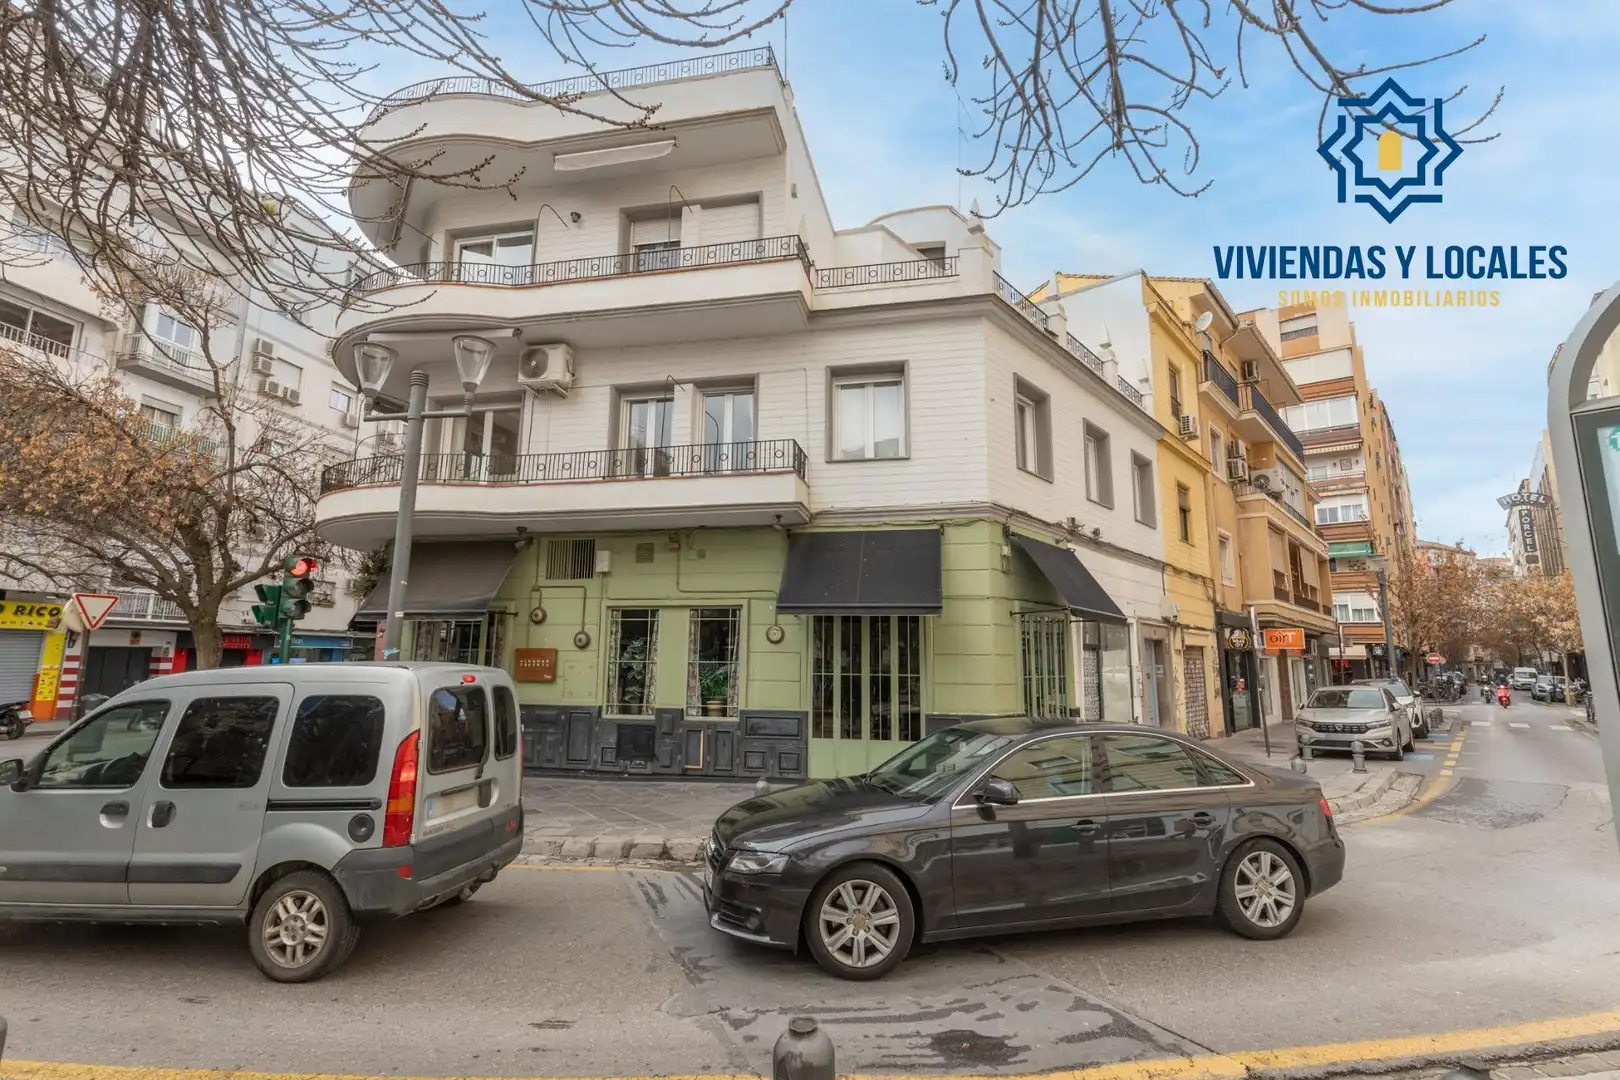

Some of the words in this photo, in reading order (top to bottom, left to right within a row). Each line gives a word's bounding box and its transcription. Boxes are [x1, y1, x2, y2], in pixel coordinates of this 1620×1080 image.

[1501, 493, 1546, 505] HOTEL
[1521, 510, 1535, 552] PORCEL
[13, 604, 61, 618] RICO
